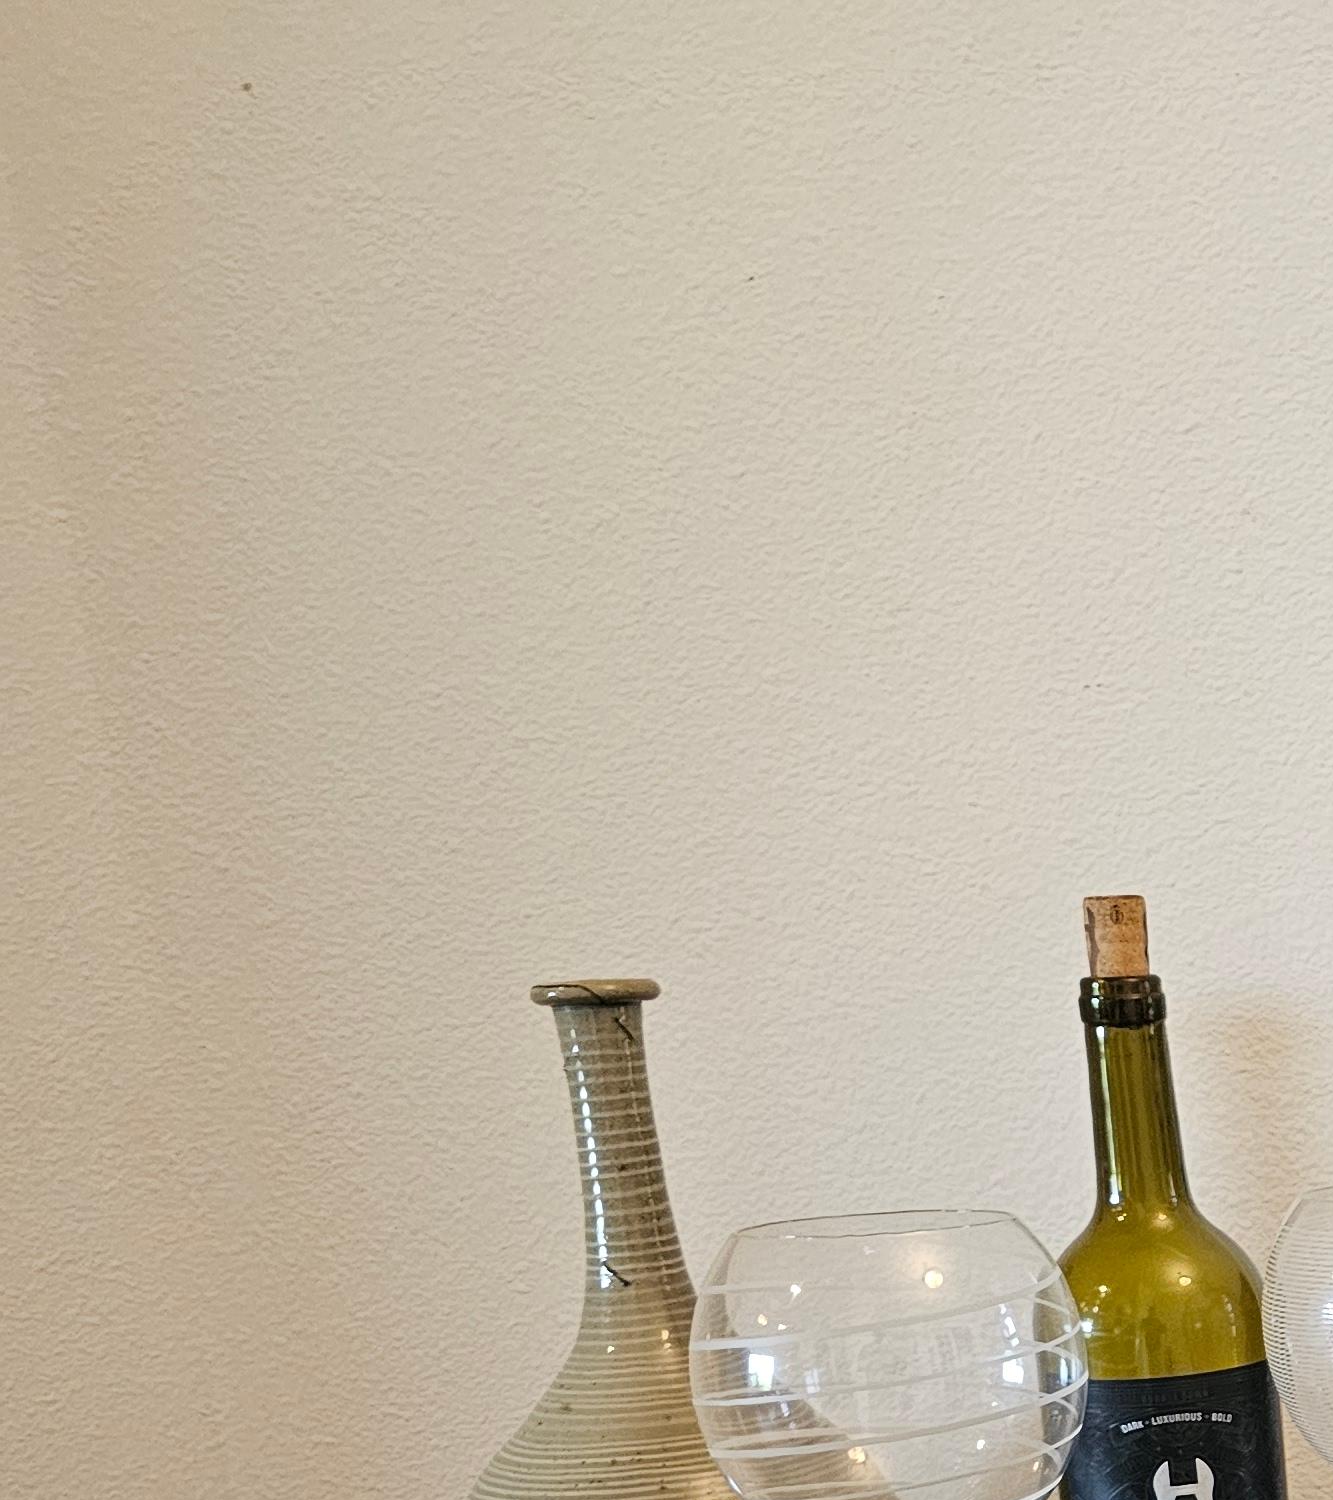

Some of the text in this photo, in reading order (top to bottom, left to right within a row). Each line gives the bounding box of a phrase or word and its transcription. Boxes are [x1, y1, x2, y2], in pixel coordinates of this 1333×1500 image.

[1120, 1412, 1232, 1434] DARK LUXURIOUS BOLD
